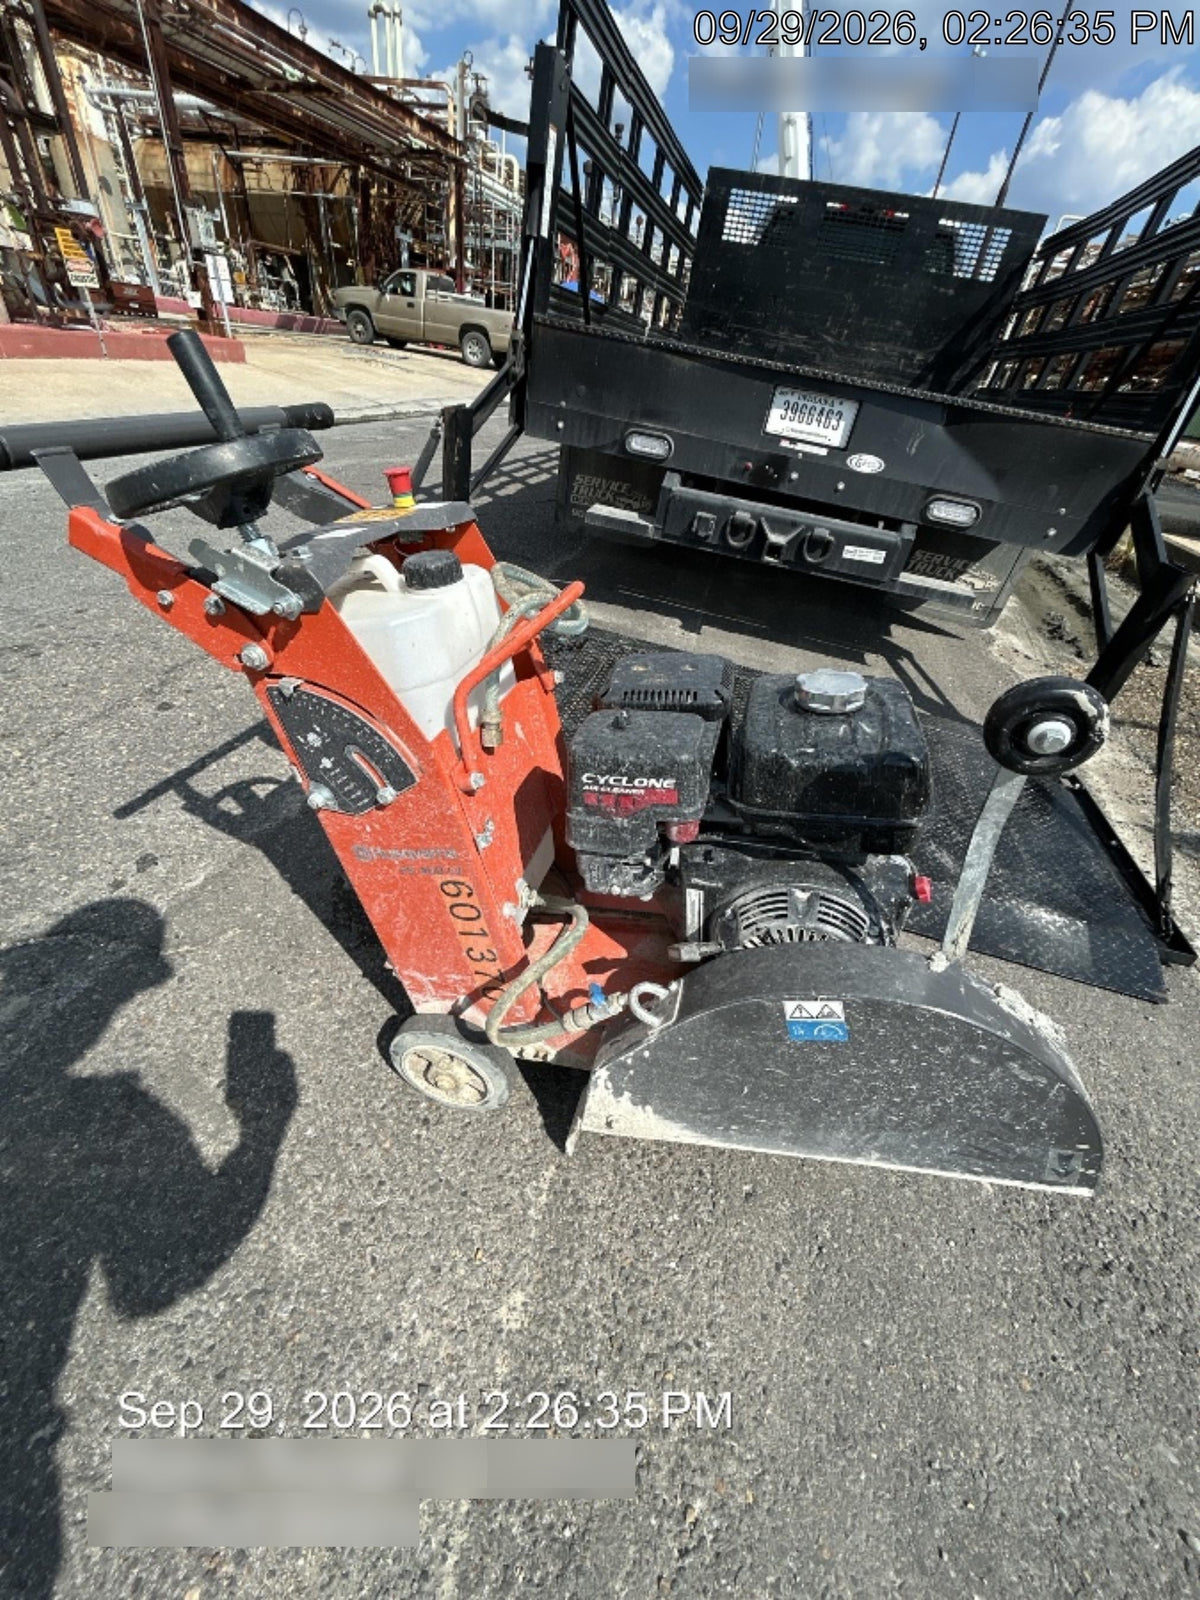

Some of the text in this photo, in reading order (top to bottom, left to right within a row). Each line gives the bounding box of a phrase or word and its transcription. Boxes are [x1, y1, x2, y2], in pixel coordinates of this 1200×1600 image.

[780, 399, 844, 431] 3966463
[906, 559, 957, 583] TRUCK
[581, 773, 677, 789] CYCLONE
